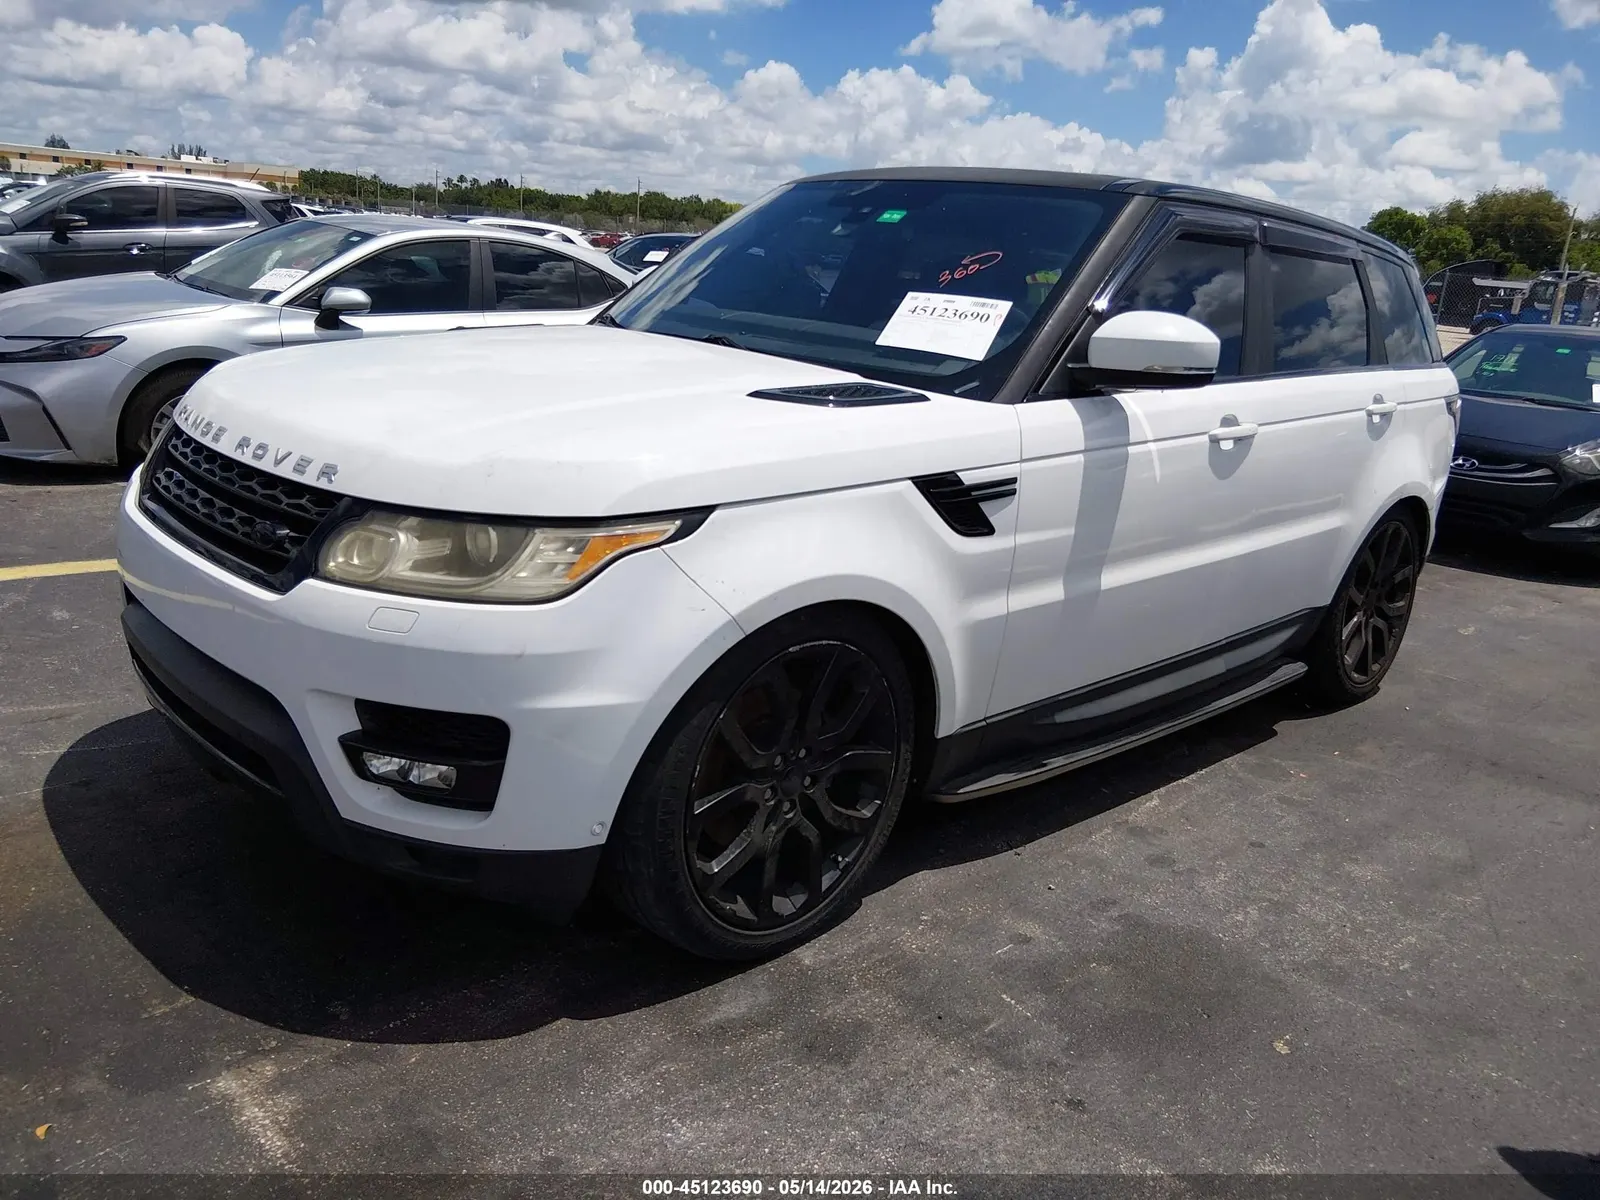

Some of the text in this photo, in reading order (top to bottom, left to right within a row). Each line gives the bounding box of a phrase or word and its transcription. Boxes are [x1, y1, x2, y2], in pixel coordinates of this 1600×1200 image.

[907, 304, 991, 324] 45123690
[179, 404, 340, 484] RANGE ROVER
